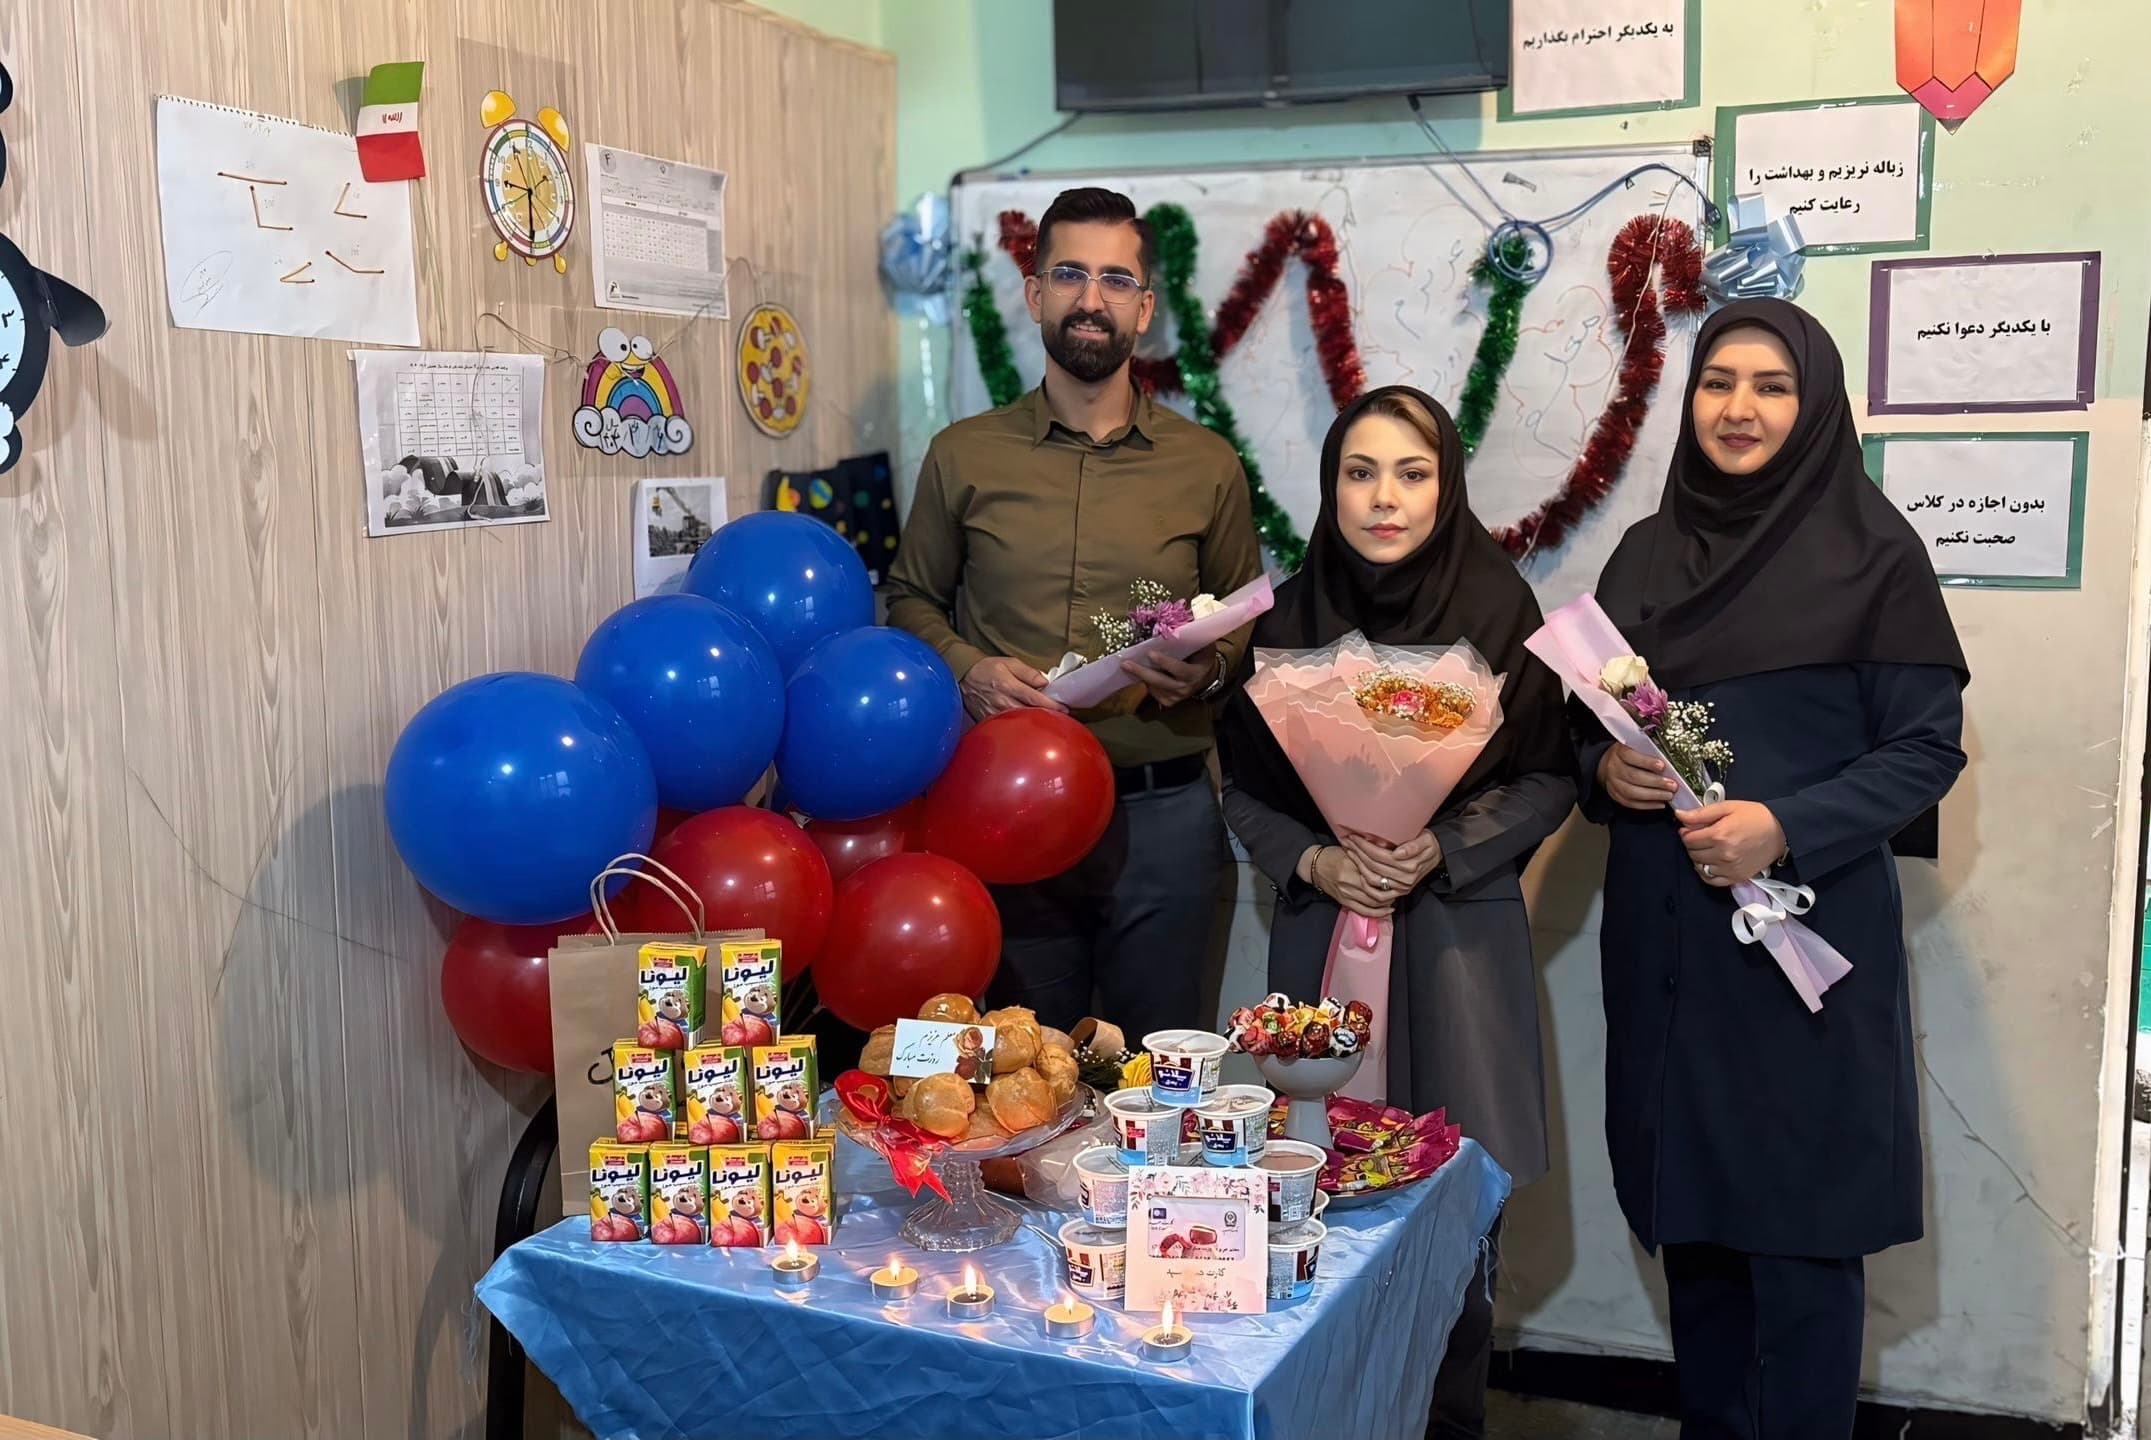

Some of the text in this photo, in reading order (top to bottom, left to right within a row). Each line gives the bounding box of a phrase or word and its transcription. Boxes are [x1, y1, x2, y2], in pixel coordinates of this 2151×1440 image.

[1523, 22, 1674, 50] به یکدیگر احترام بگذاریم
[1749, 160, 1904, 185] زباله نریزیم و بهداشت را
[1789, 197, 1860, 216] رعایت کنیم
[1917, 318, 2051, 340] با یکدیگر دعوا نکنیم
[1907, 494, 2045, 513] بدون اجازه در کلاس
[1936, 530, 2016, 548] صحبت نکنیم
[640, 967, 687, 986] لیونا
[724, 959, 774, 982] لیونا
[919, 1030, 957, 1048] معلم عزیزم
[896, 1041, 941, 1069] روزت مبارک
[618, 1059, 668, 1081] لیونا
[688, 1059, 738, 1083] لیونا
[756, 1058, 804, 1080] لیونا
[592, 1163, 640, 1183] لیونا
[653, 1161, 702, 1183] لیونا
[712, 1164, 761, 1185] لیونا
[775, 1163, 824, 1185] لیونا
